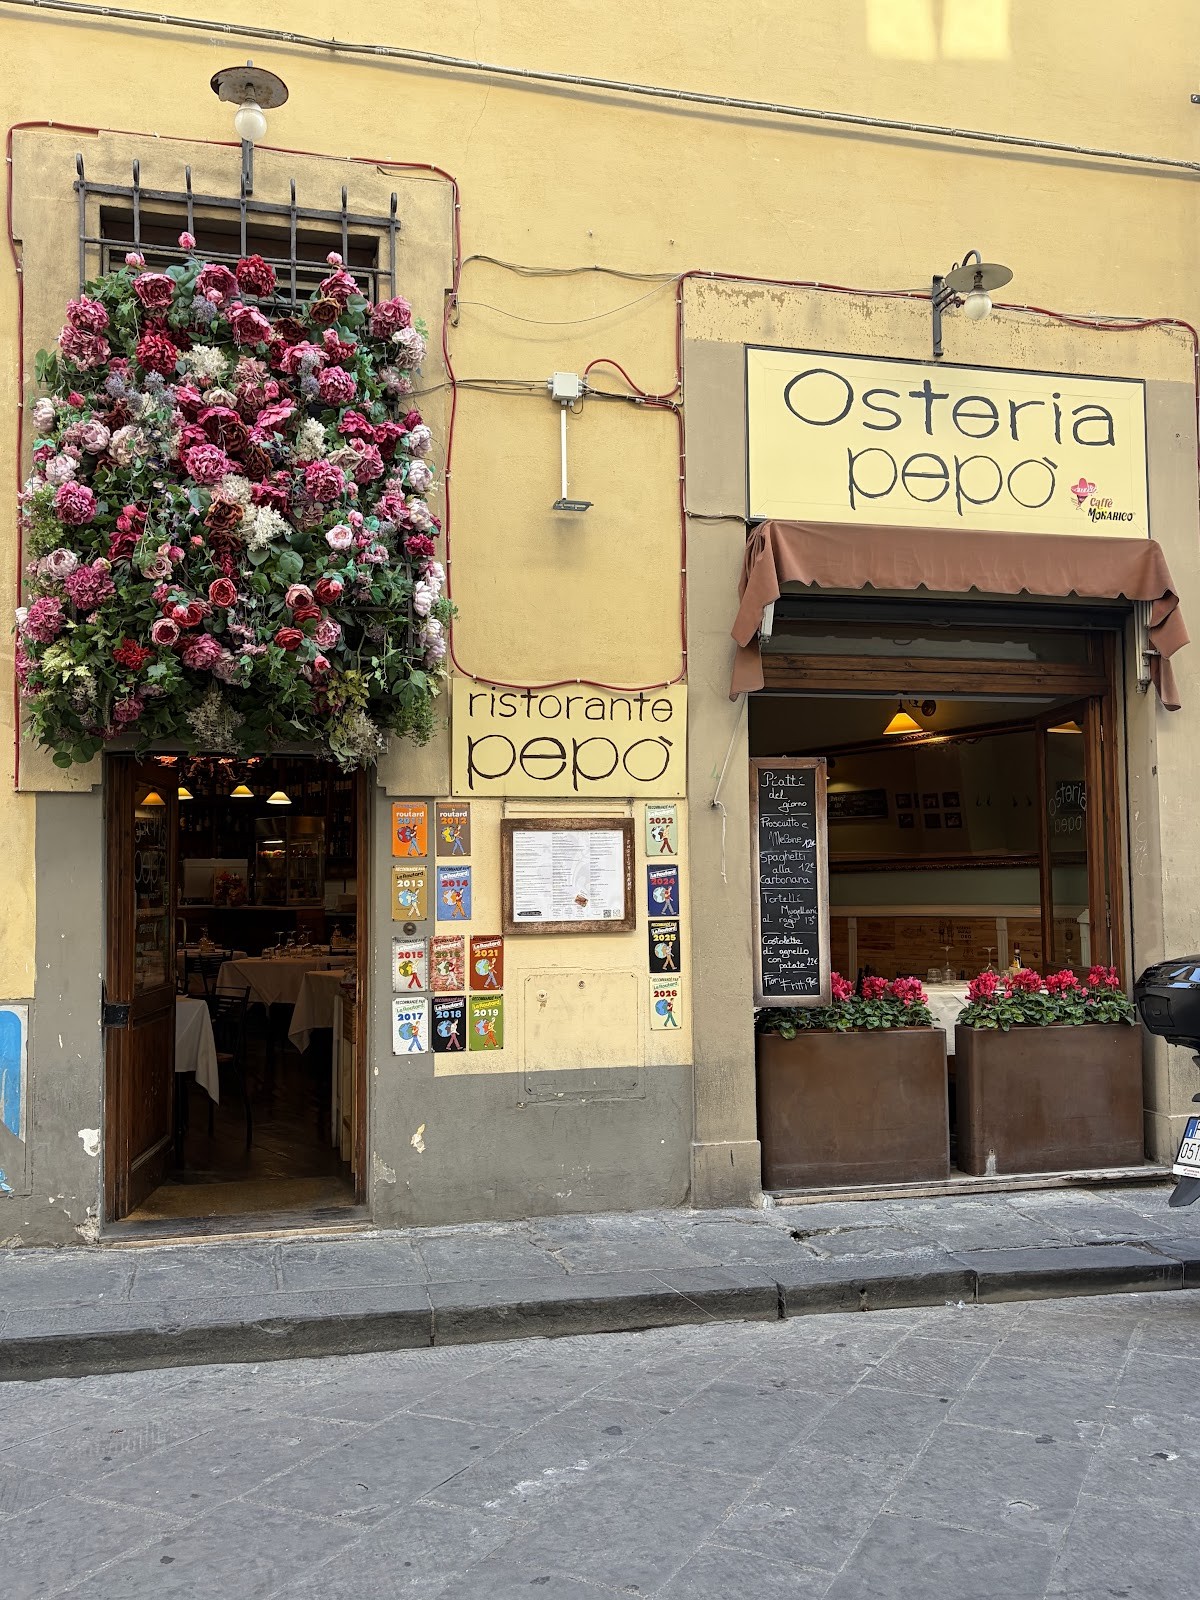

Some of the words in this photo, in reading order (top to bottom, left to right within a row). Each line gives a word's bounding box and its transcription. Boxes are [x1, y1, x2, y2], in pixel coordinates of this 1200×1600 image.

[784, 368, 1115, 447] Osteria
[848, 447, 1058, 516] pepò
[1090, 498, 1113, 510] Caffè
[468, 686, 674, 723] ristorante
[467, 734, 674, 792] pepò
[760, 772, 805, 787] Piatti
[769, 788, 788, 799] del
[1049, 782, 1087, 816] Osteria
[778, 800, 807, 812] giorno
[760, 818, 799, 828] Prosciutto
[769, 830, 802, 846] Melone
[760, 852, 806, 864] Spaghetti
[772, 865, 792, 874] alla
[760, 875, 810, 884] Carbonara
[762, 892, 804, 904] Tortelli
[762, 936, 803, 944] Costolette
[398, 951, 423, 959] 2015
[763, 947, 774, 956] di
[779, 946, 810, 958] agnello
[779, 960, 807, 972] patate
[764, 975, 781, 987] Fiori
[398, 1013, 423, 1021] 2017
[436, 1010, 461, 1018] 2018
[1180, 1142, 1200, 1161] 051
